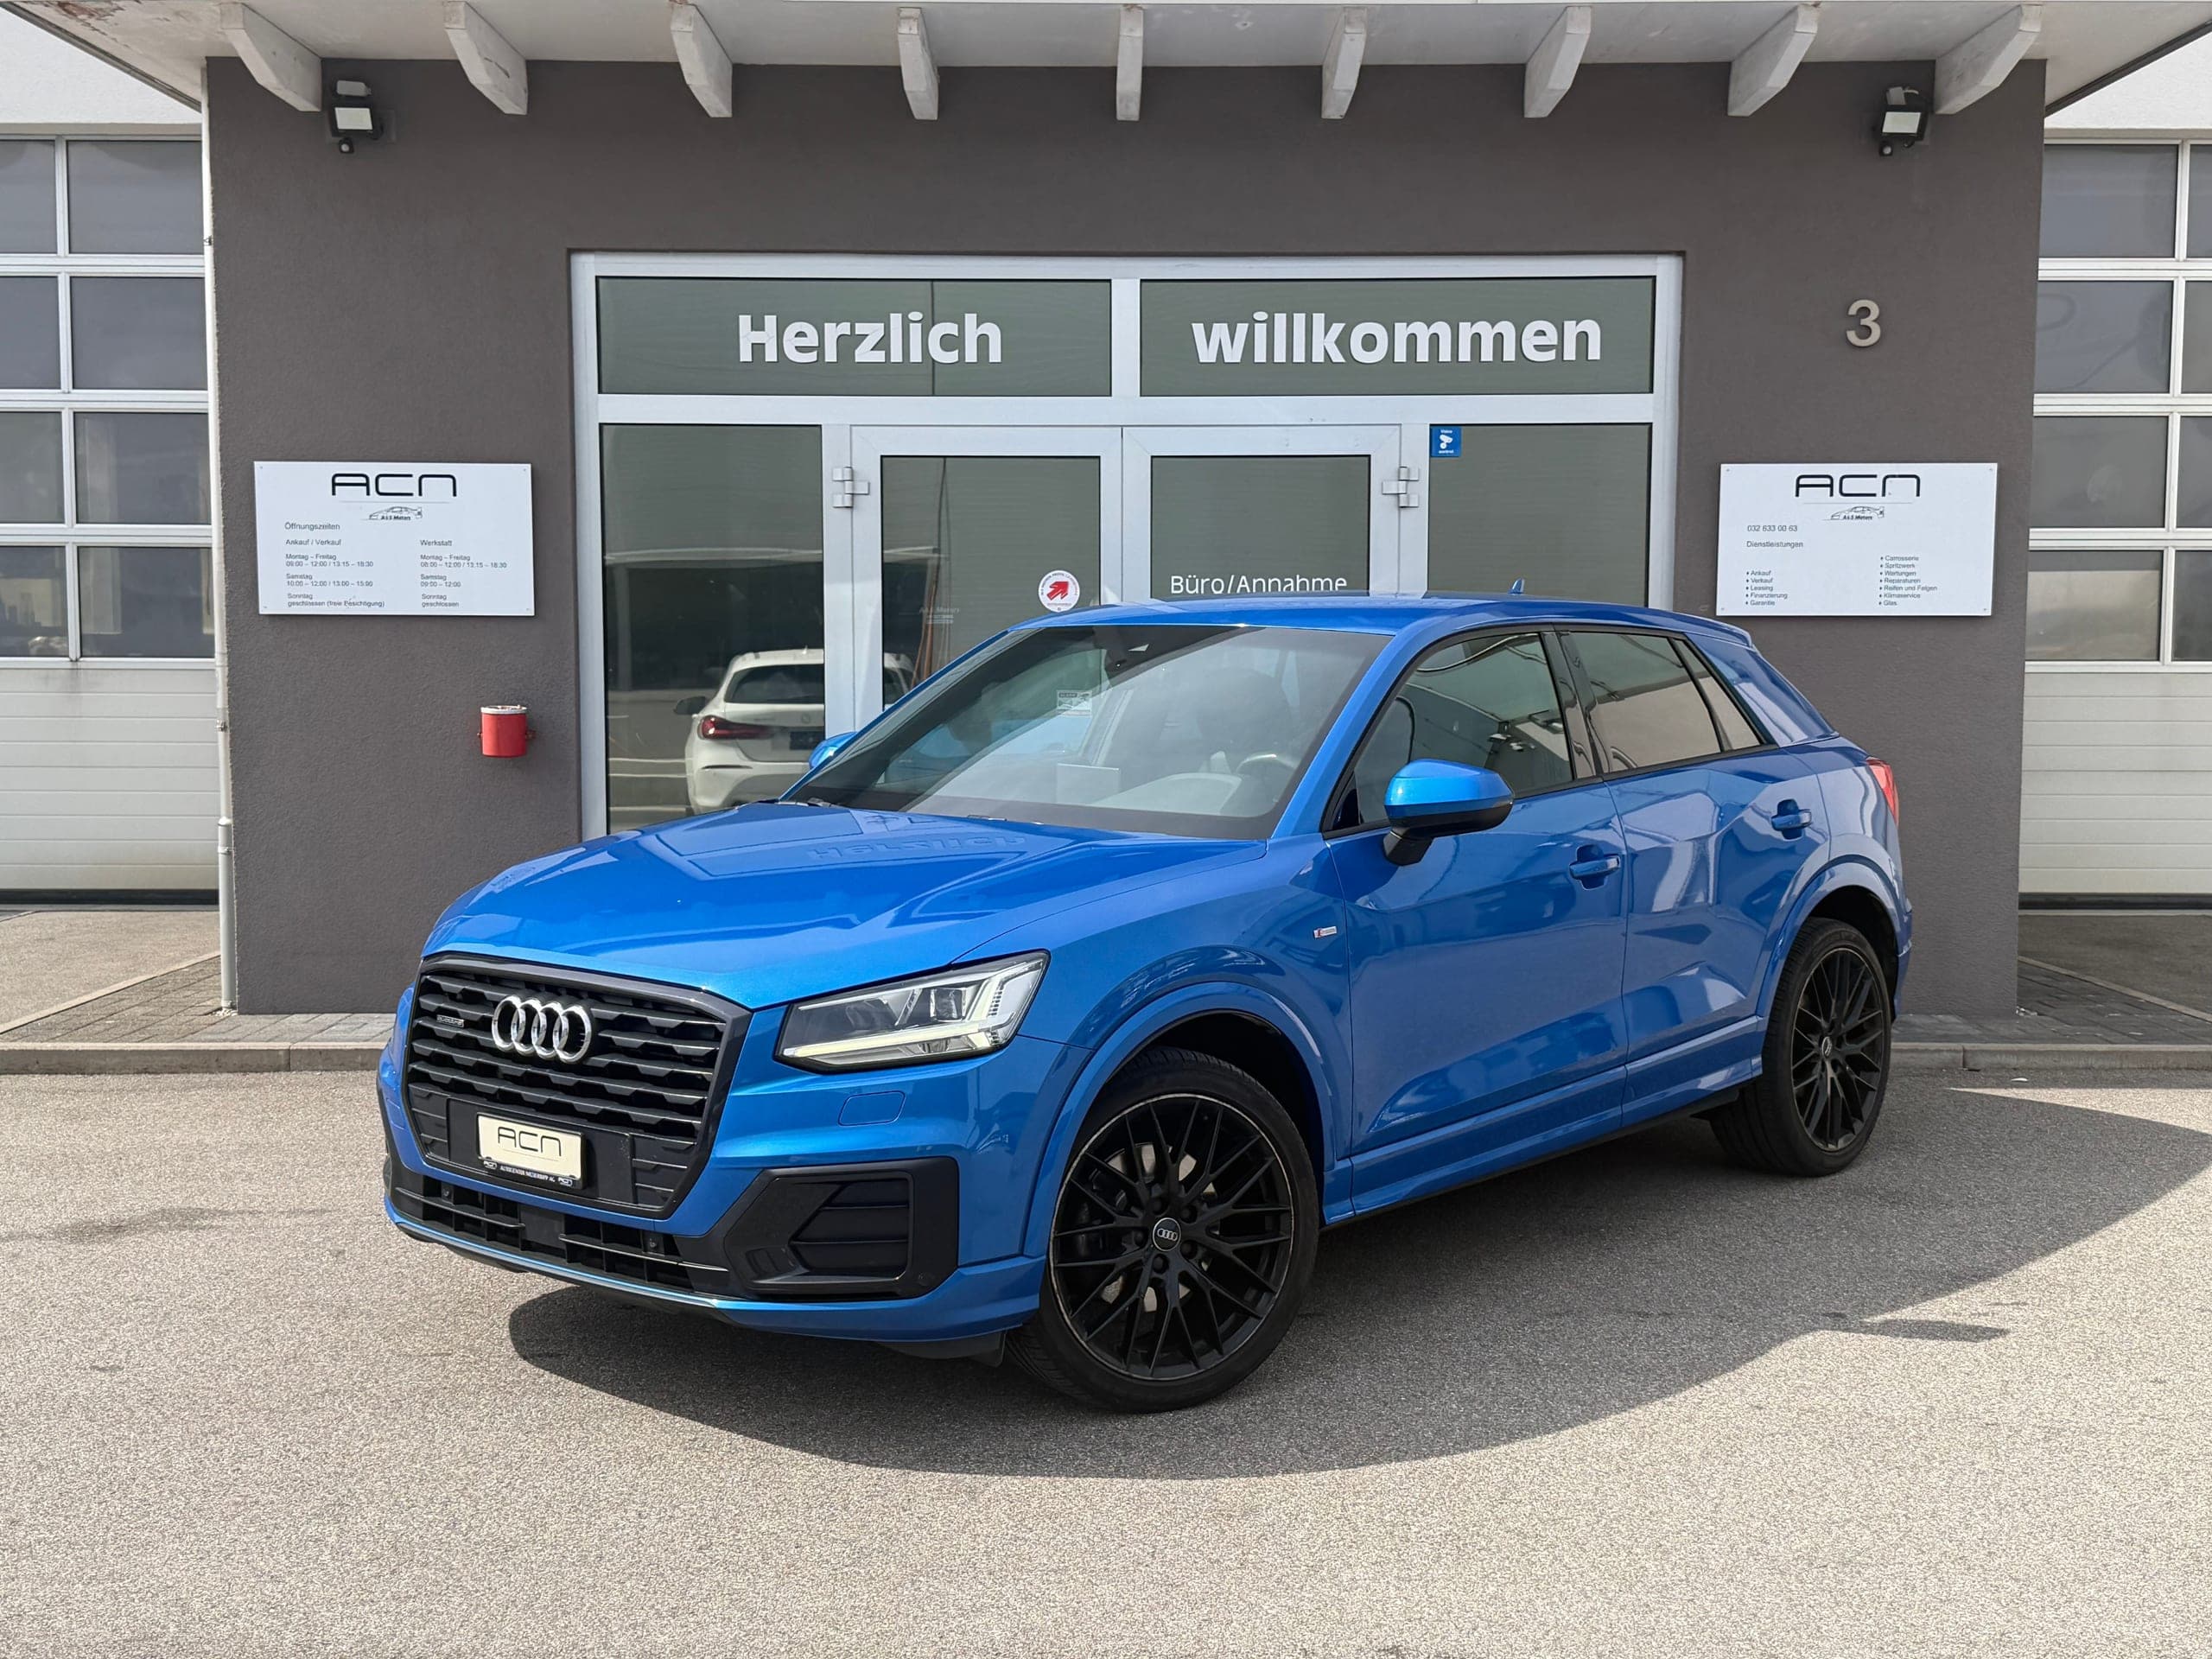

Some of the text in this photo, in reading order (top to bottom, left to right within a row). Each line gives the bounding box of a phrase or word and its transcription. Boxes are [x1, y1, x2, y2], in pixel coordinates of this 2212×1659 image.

[739, 311, 1001, 363] Herzlich
[1192, 311, 1601, 363] willkommen
[1847, 299, 1881, 347] 3
[285, 522, 340, 531] Öffnungszeiten
[1171, 575, 1347, 594] Büro/Annahme
